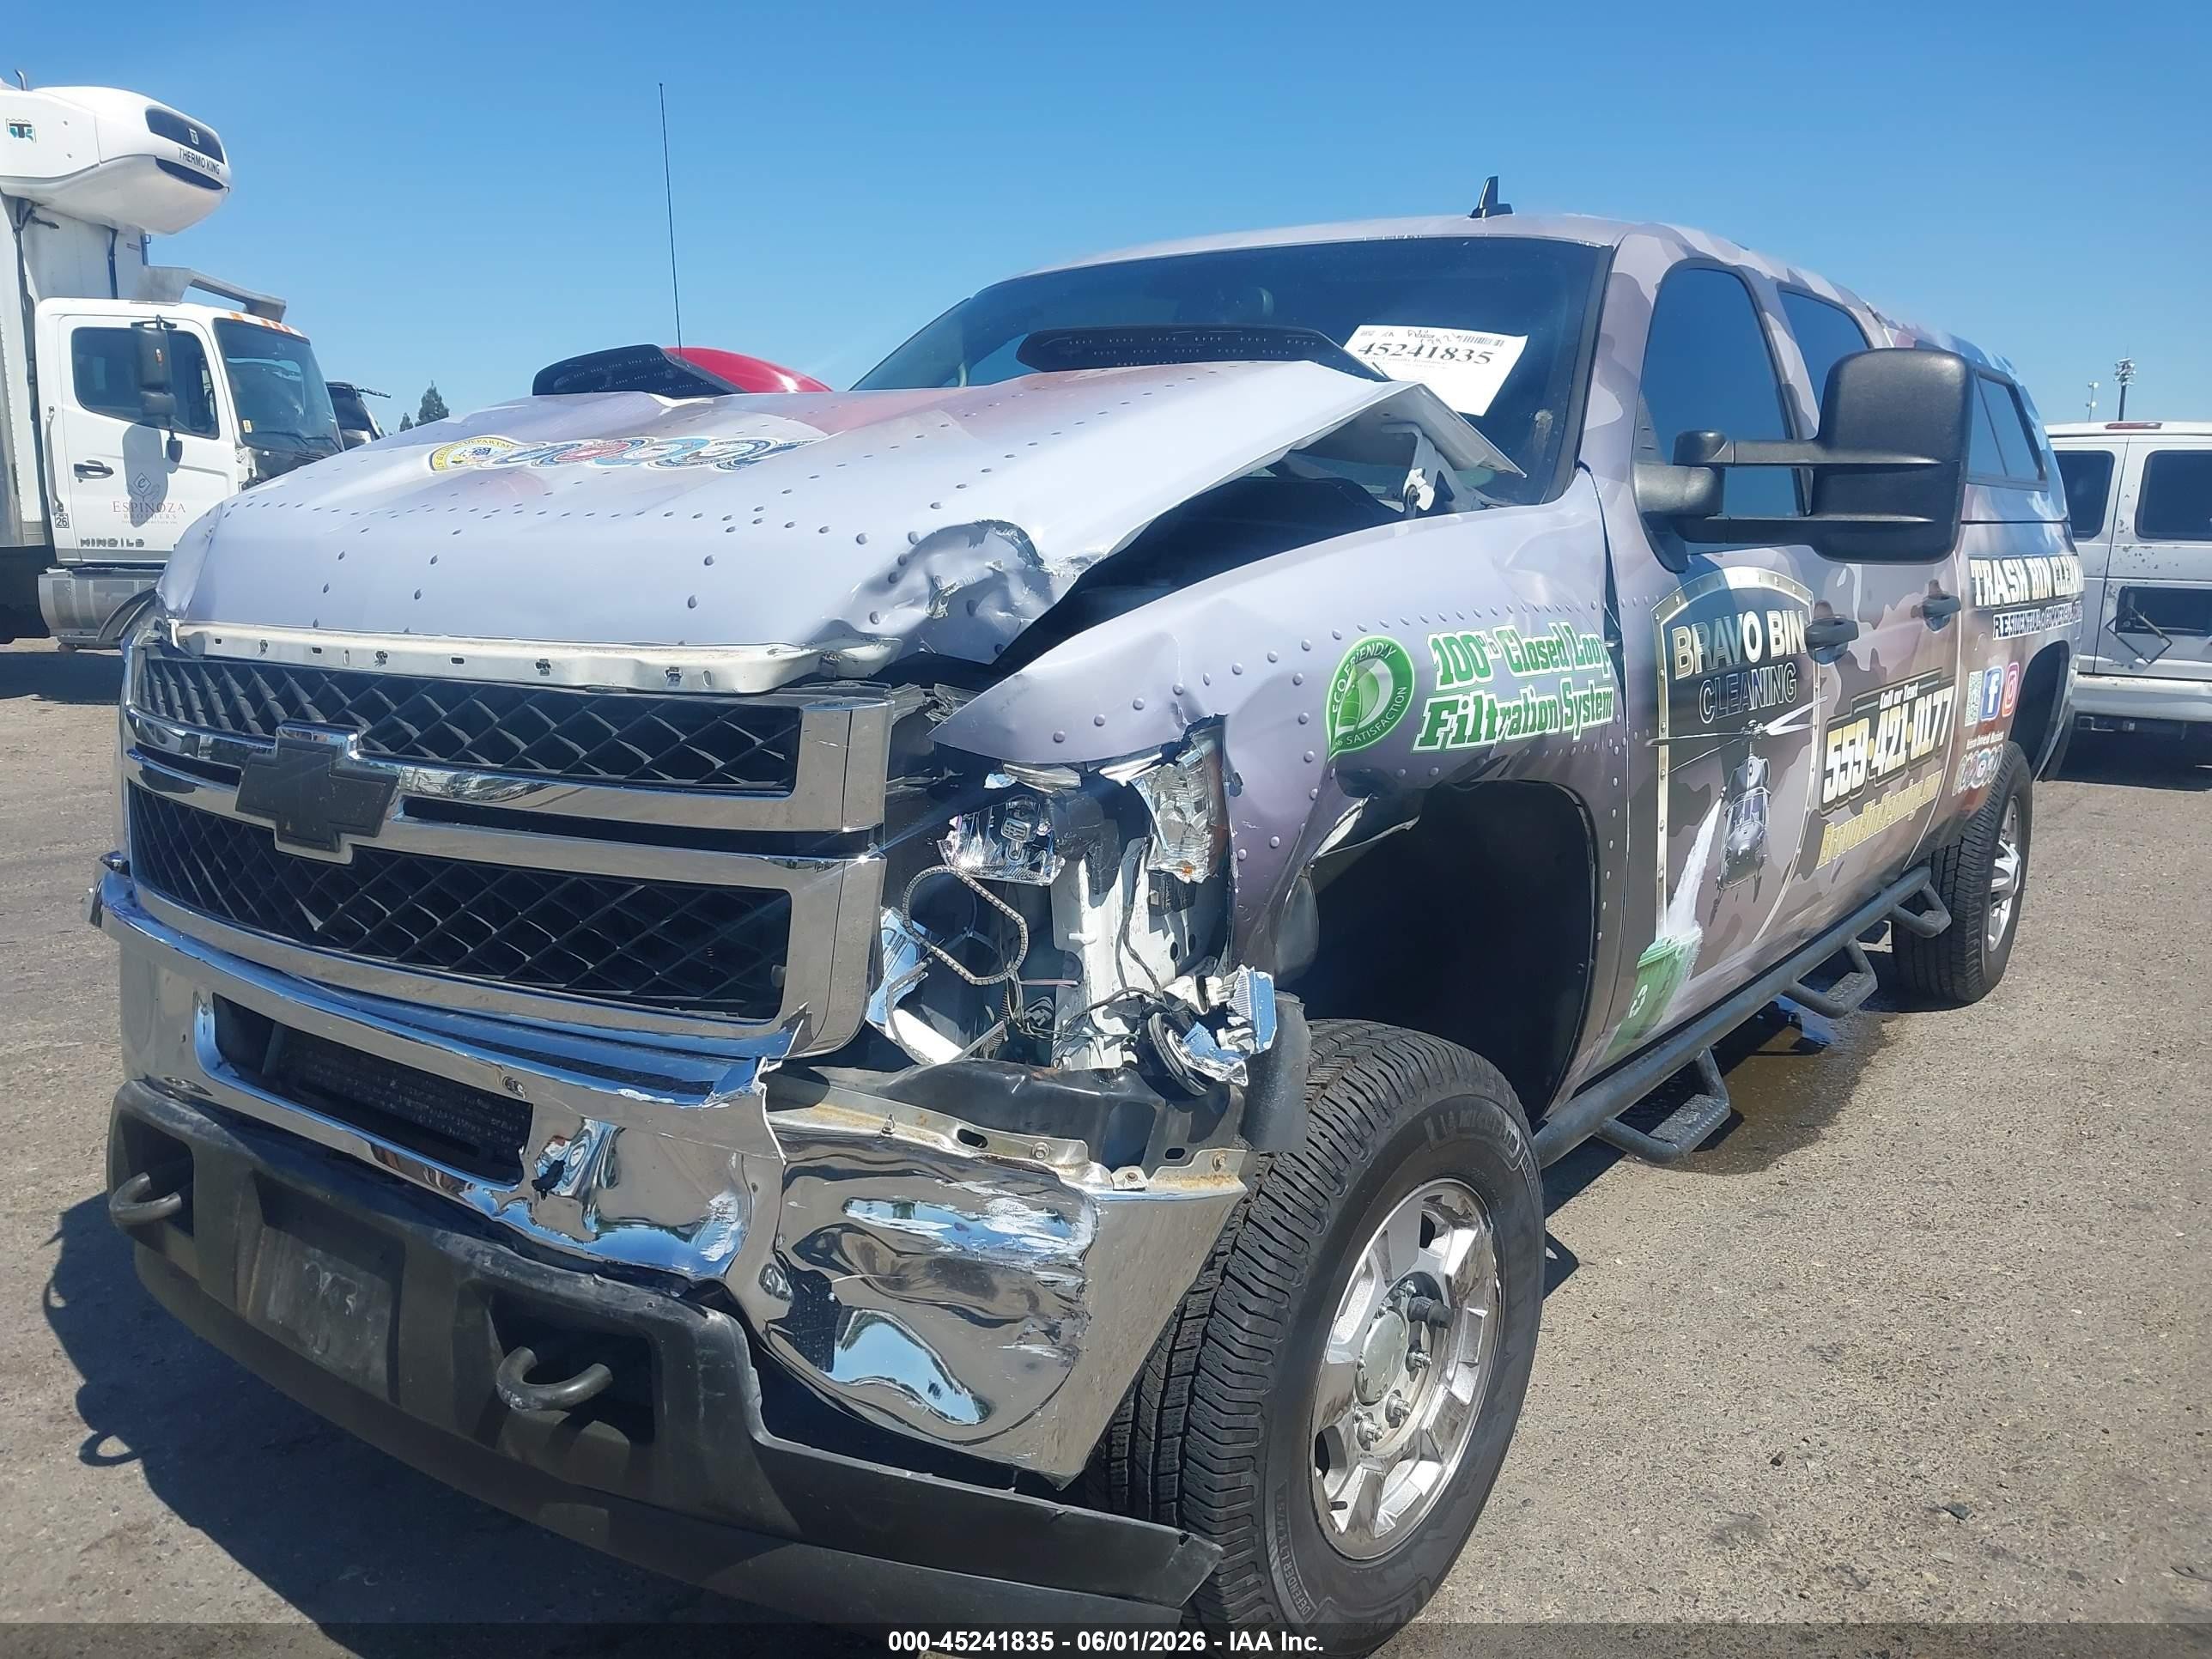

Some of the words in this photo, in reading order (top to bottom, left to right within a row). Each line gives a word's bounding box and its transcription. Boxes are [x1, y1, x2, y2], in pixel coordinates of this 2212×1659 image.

[178, 146, 206, 169] THERMO
[206, 158, 221, 175] KING
[1358, 342, 1495, 365] 45241835
[56, 517, 68, 527] 26
[112, 501, 186, 514] ESPINOZA
[1969, 559, 2029, 606] TRASH
[2025, 556, 2053, 600] BIN
[1428, 630, 1502, 691] 100%
[1492, 622, 1571, 678] Closed
[1561, 621, 1611, 679] Loop
[1671, 611, 1763, 681] BRAVO
[1765, 610, 1808, 660] BIN
[1346, 686, 1408, 746] SATISFACTION
[1413, 684, 1560, 751] Filtration
[1559, 677, 1614, 741] System
[1698, 662, 1797, 724] CLEANING
[1879, 689, 1894, 710] Call
[1893, 689, 1904, 705] or
[1903, 682, 1919, 702] Text
[1281, 1559, 1312, 1616] DEFENDER
